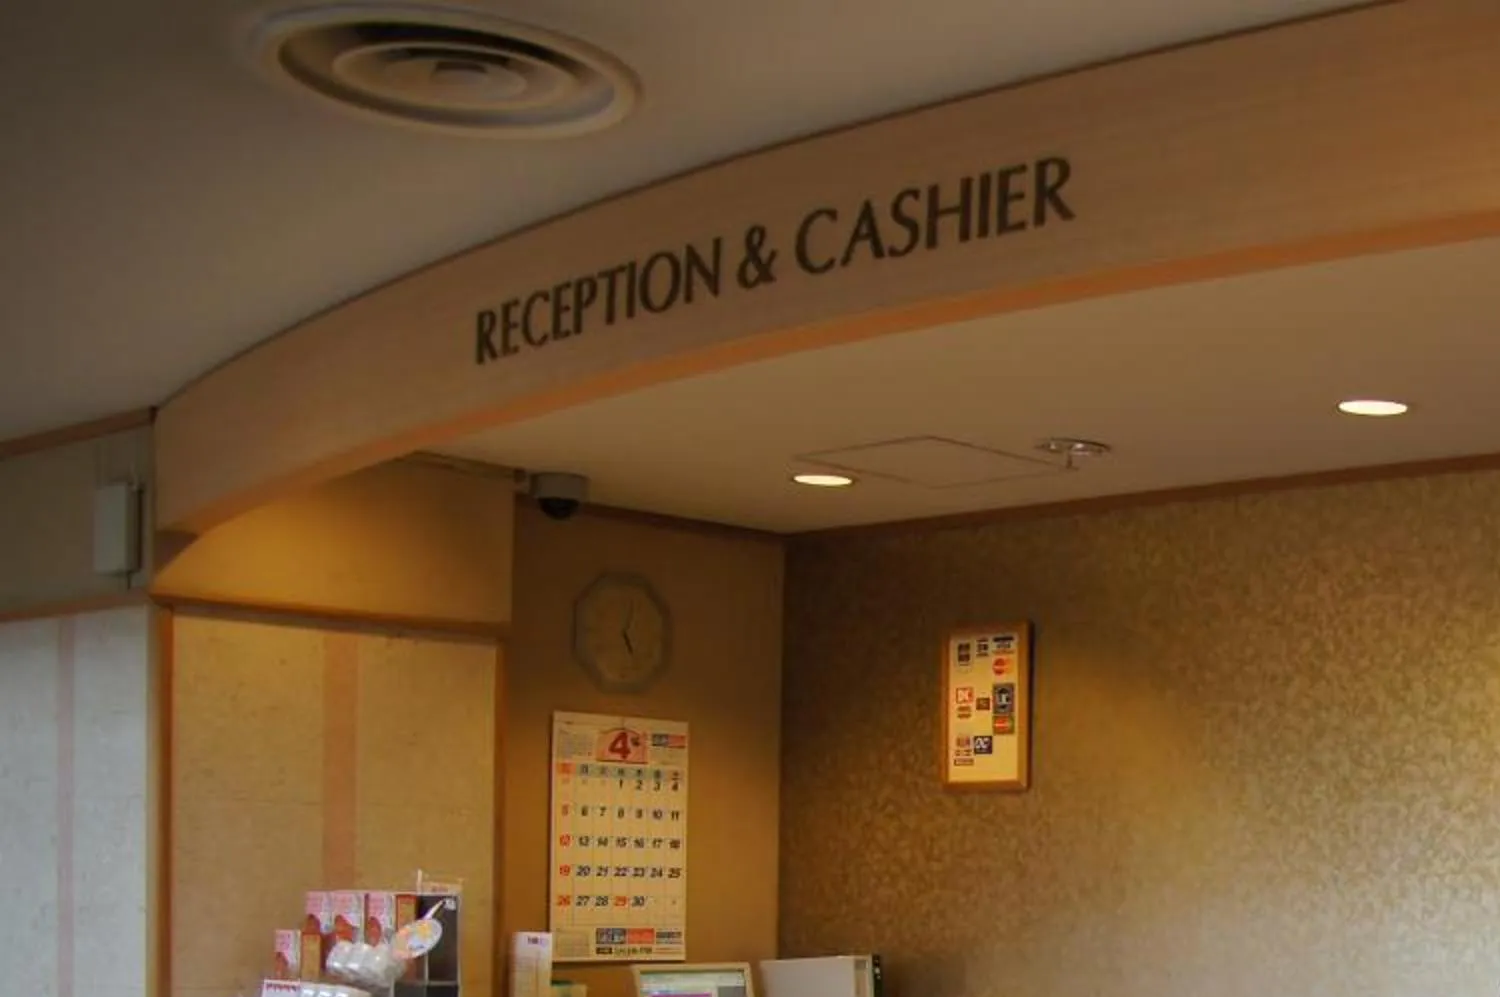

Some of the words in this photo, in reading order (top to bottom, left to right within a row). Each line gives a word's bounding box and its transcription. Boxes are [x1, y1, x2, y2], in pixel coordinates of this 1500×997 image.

[475, 236, 722, 365] RECEPTION
[736, 224, 777, 289] &
[794, 156, 1076, 275] CASHIER
[608, 731, 631, 759] 4
[576, 865, 590, 876] 20
[576, 896, 589, 906] 27
